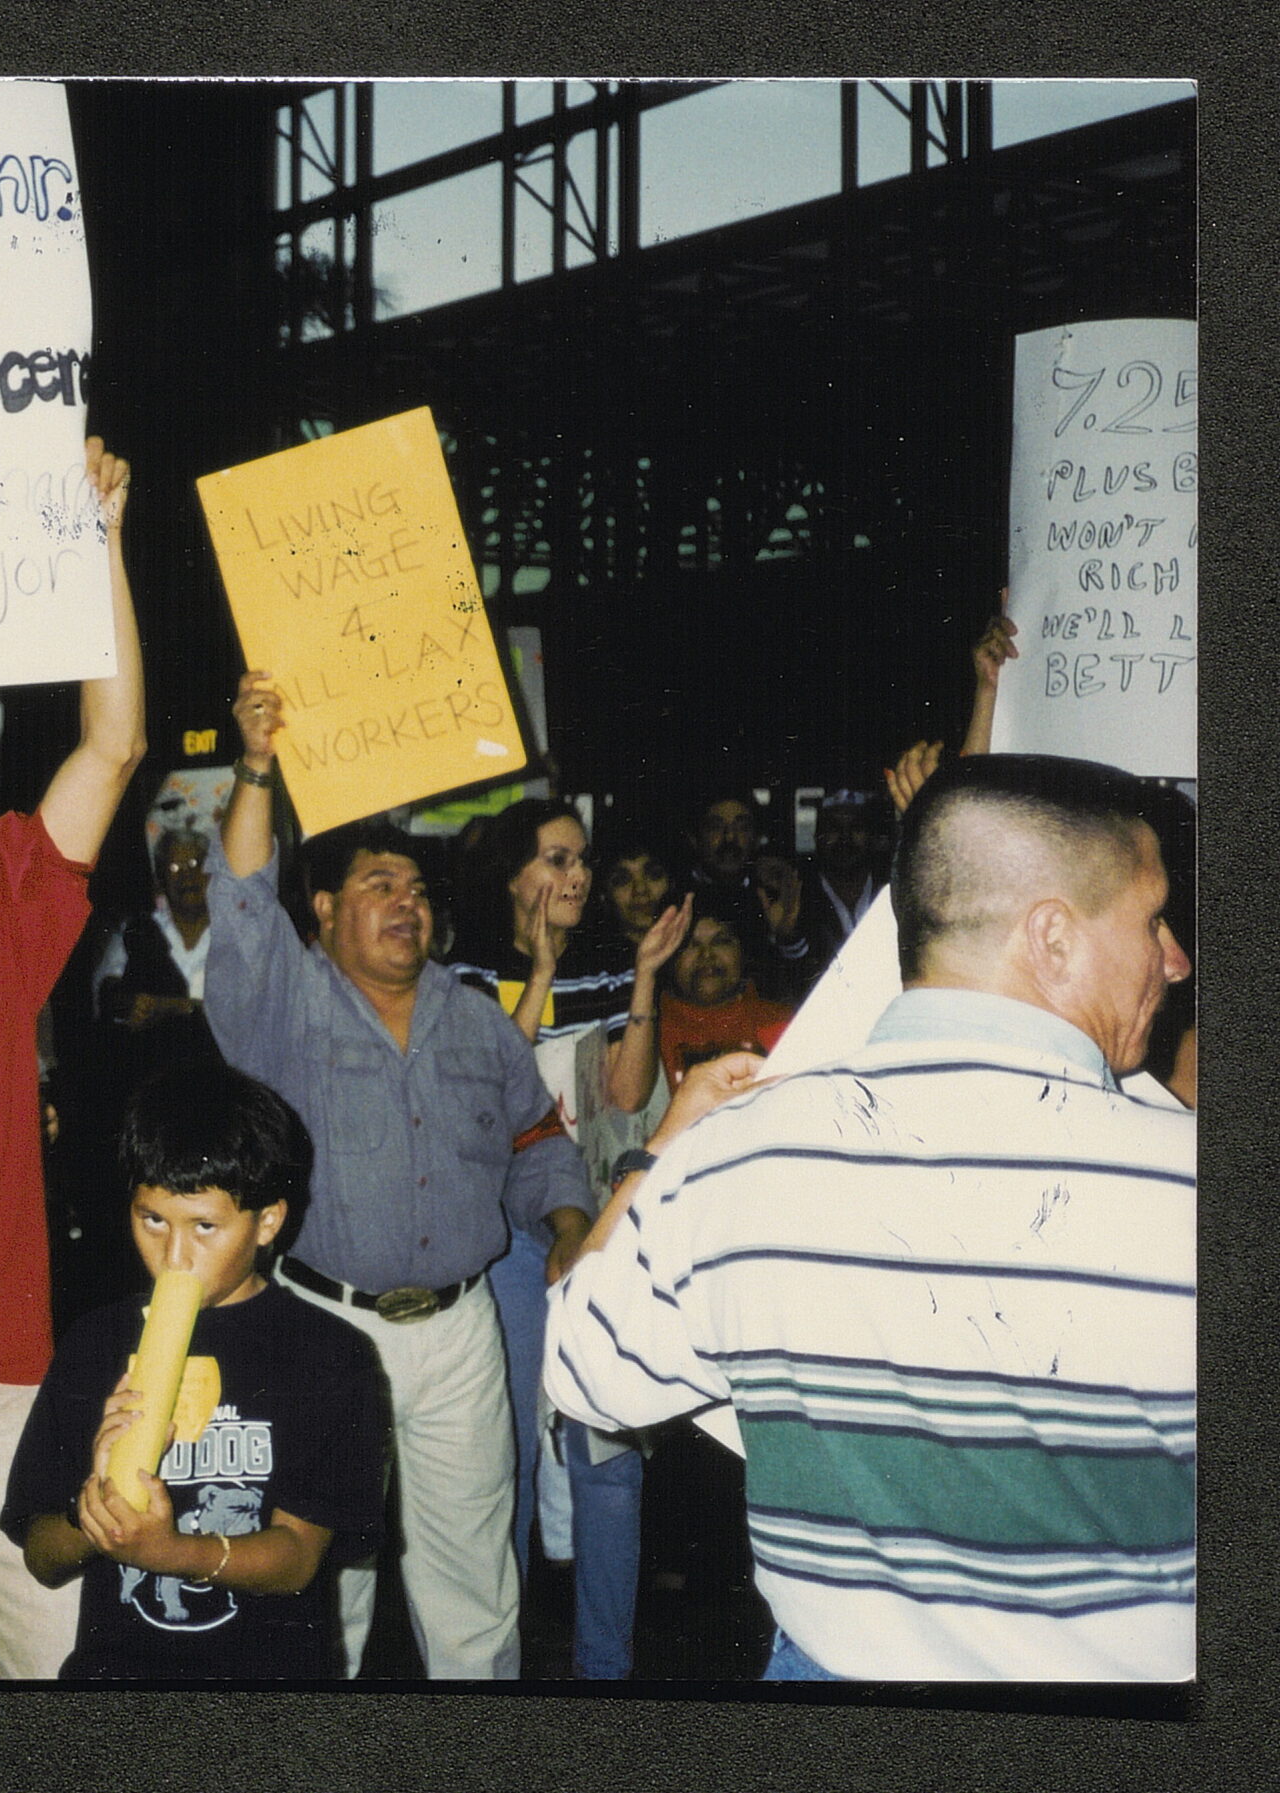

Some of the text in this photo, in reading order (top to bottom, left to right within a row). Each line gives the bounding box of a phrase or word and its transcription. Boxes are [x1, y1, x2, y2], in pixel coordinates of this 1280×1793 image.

[1047, 460, 1158, 503] PLUS
[245, 482, 401, 551] LIVING
[1047, 514, 1166, 551] WON'T
[279, 527, 425, 600] WAGE
[1078, 557, 1180, 595] RICH
[341, 603, 374, 643] 4
[1041, 607, 1141, 641] WE'LL
[380, 614, 481, 680] LAX
[1045, 651, 1197, 698] BETT
[289, 681, 505, 771] WORKERS
